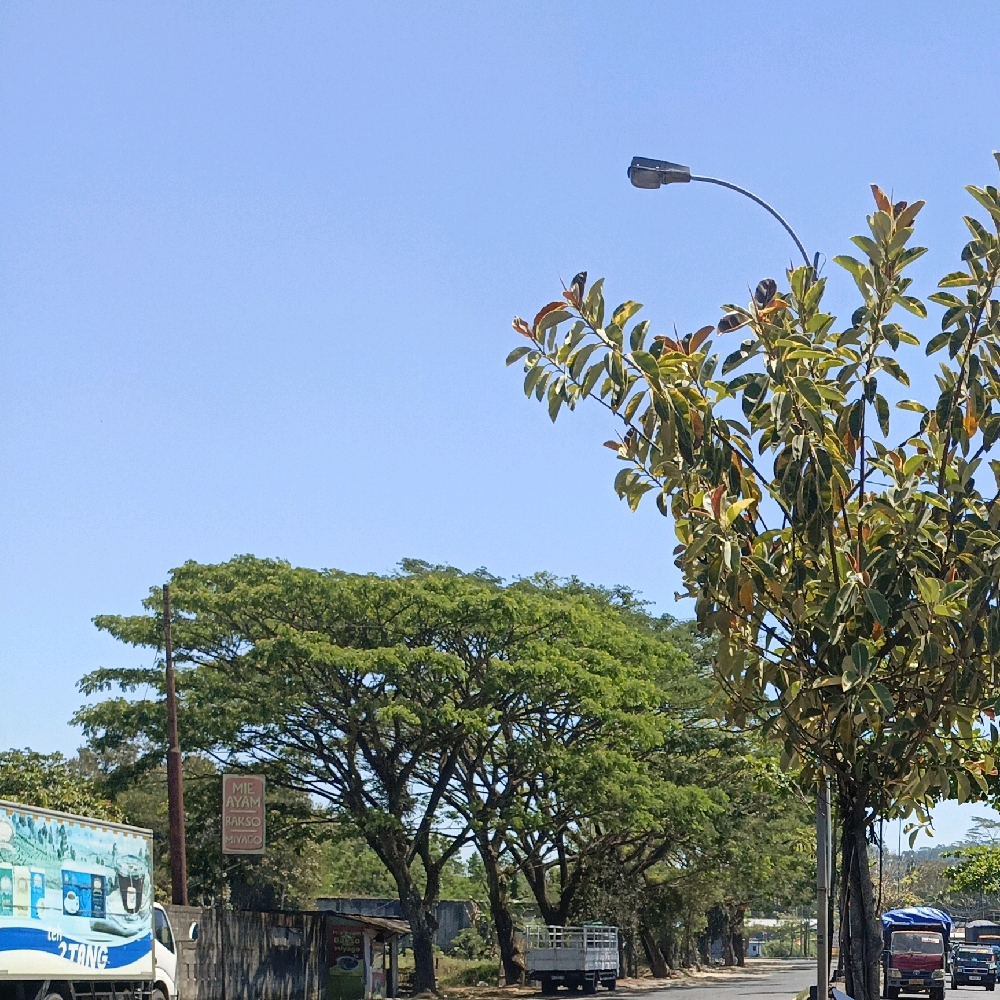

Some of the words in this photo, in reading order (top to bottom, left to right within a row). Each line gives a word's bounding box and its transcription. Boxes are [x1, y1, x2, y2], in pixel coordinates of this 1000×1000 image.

[232, 782, 255, 794] MIE
[226, 795, 260, 808] AYAM
[225, 816, 261, 827] BAKSO
